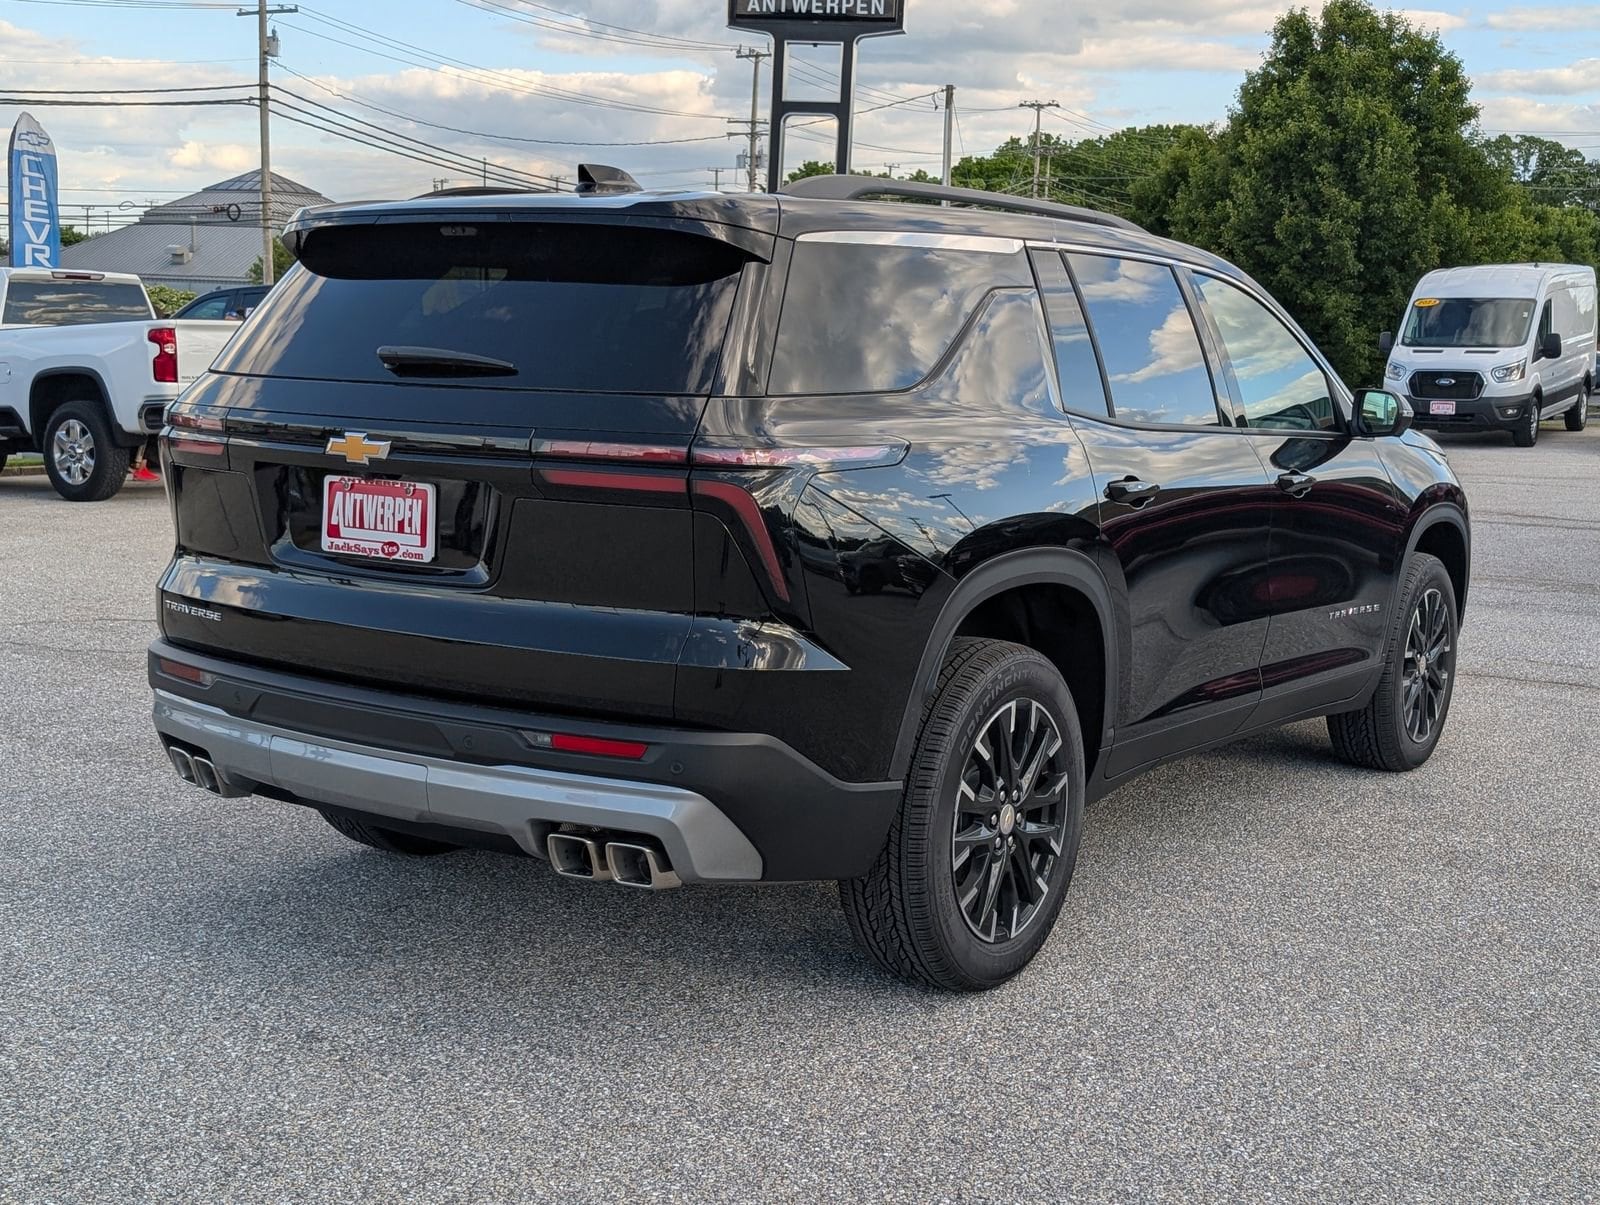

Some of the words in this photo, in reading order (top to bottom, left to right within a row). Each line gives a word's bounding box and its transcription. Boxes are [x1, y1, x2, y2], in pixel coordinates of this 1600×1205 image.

[747, 0, 884, 15] ANTWERPEN
[20, 154, 53, 268] CHEVR
[330, 491, 422, 535] ANTWERPEN
[327, 541, 380, 557] JackSays
[382, 544, 398, 553] Yes
[399, 549, 424, 560] .com
[165, 600, 222, 621] TRAVERSE
[1329, 604, 1380, 619] TRAVERSE
[960, 666, 1042, 756] CONTINENTA
